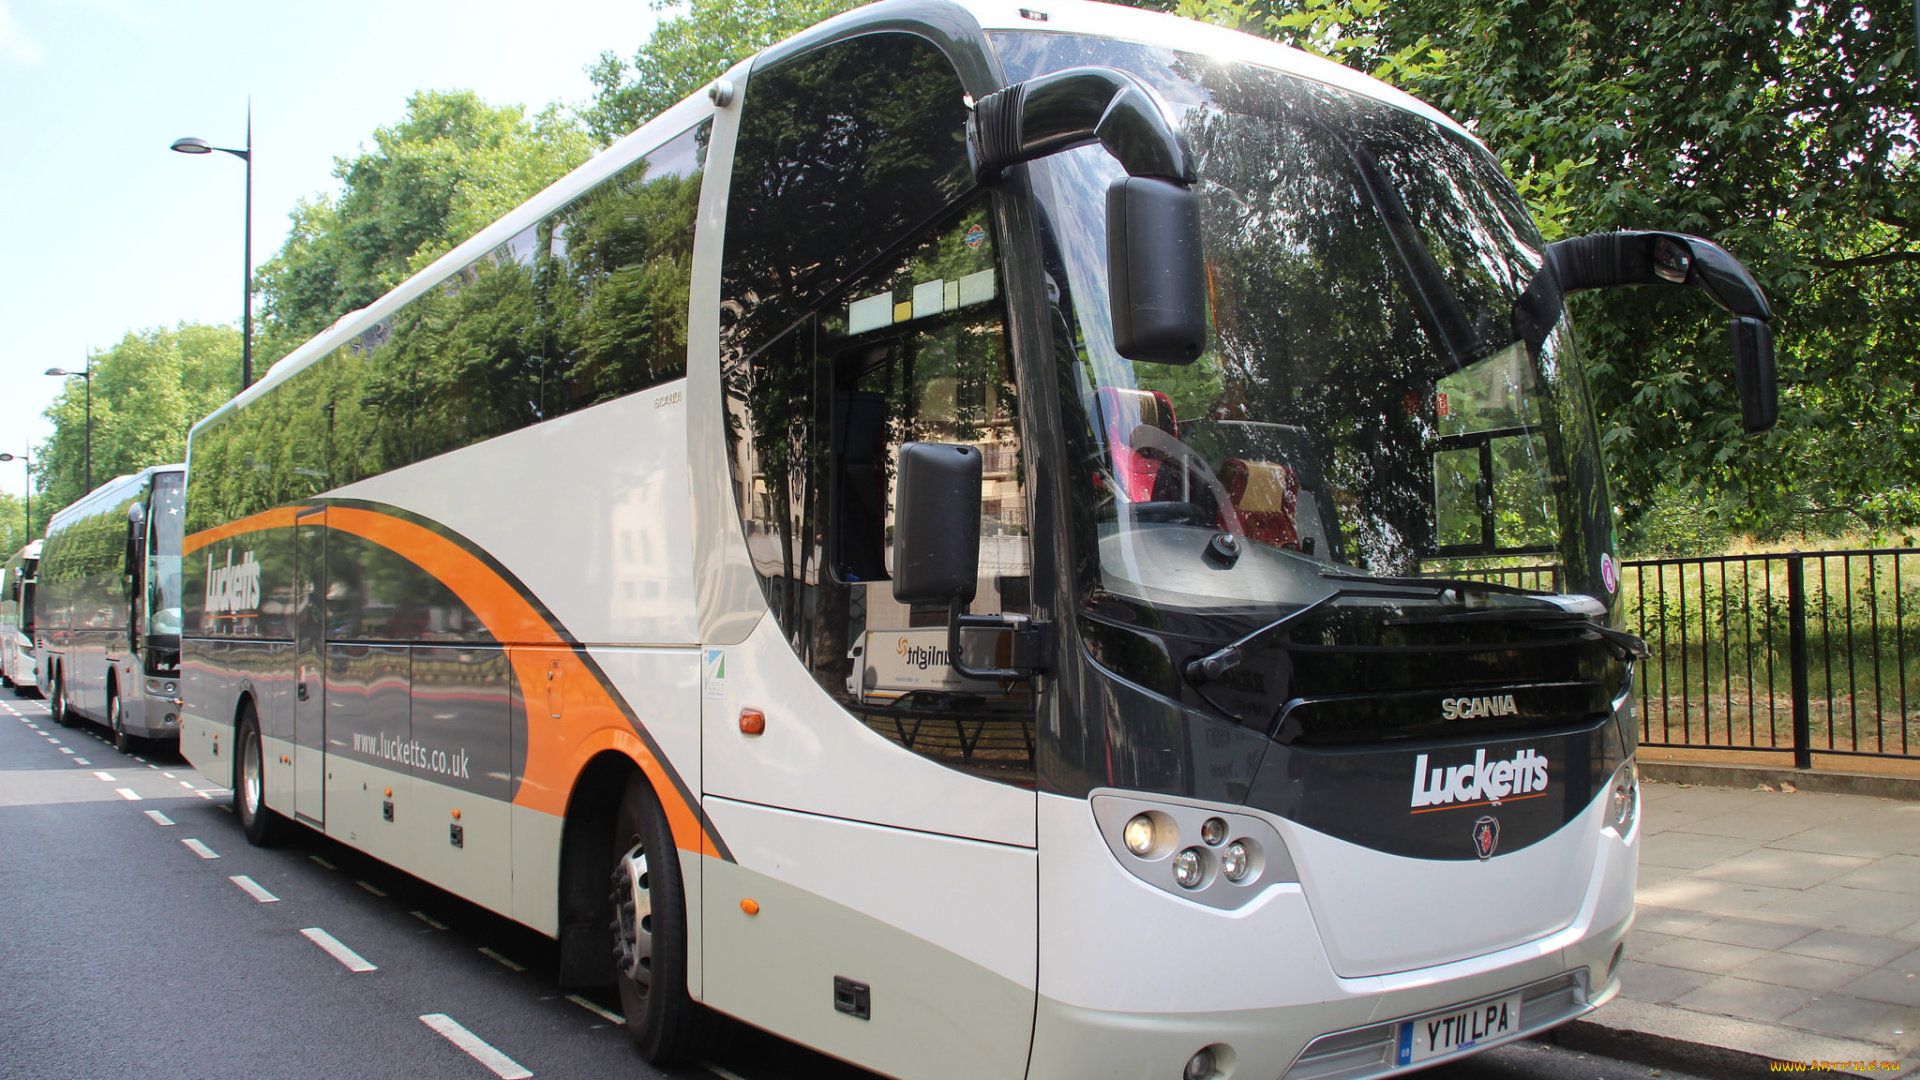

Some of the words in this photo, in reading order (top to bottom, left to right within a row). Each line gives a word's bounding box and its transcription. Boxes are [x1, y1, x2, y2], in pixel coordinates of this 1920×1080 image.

[205, 548, 261, 612] Lucketts
[1442, 694, 1519, 720] SCANIA
[353, 732, 470, 779] www.lucketts.co.uk
[1411, 748, 1549, 808] Lucketts
[1428, 1013, 1467, 1052] YT11
[1472, 1002, 1508, 1040] LPA
[1401, 1048, 1410, 1058] GB
